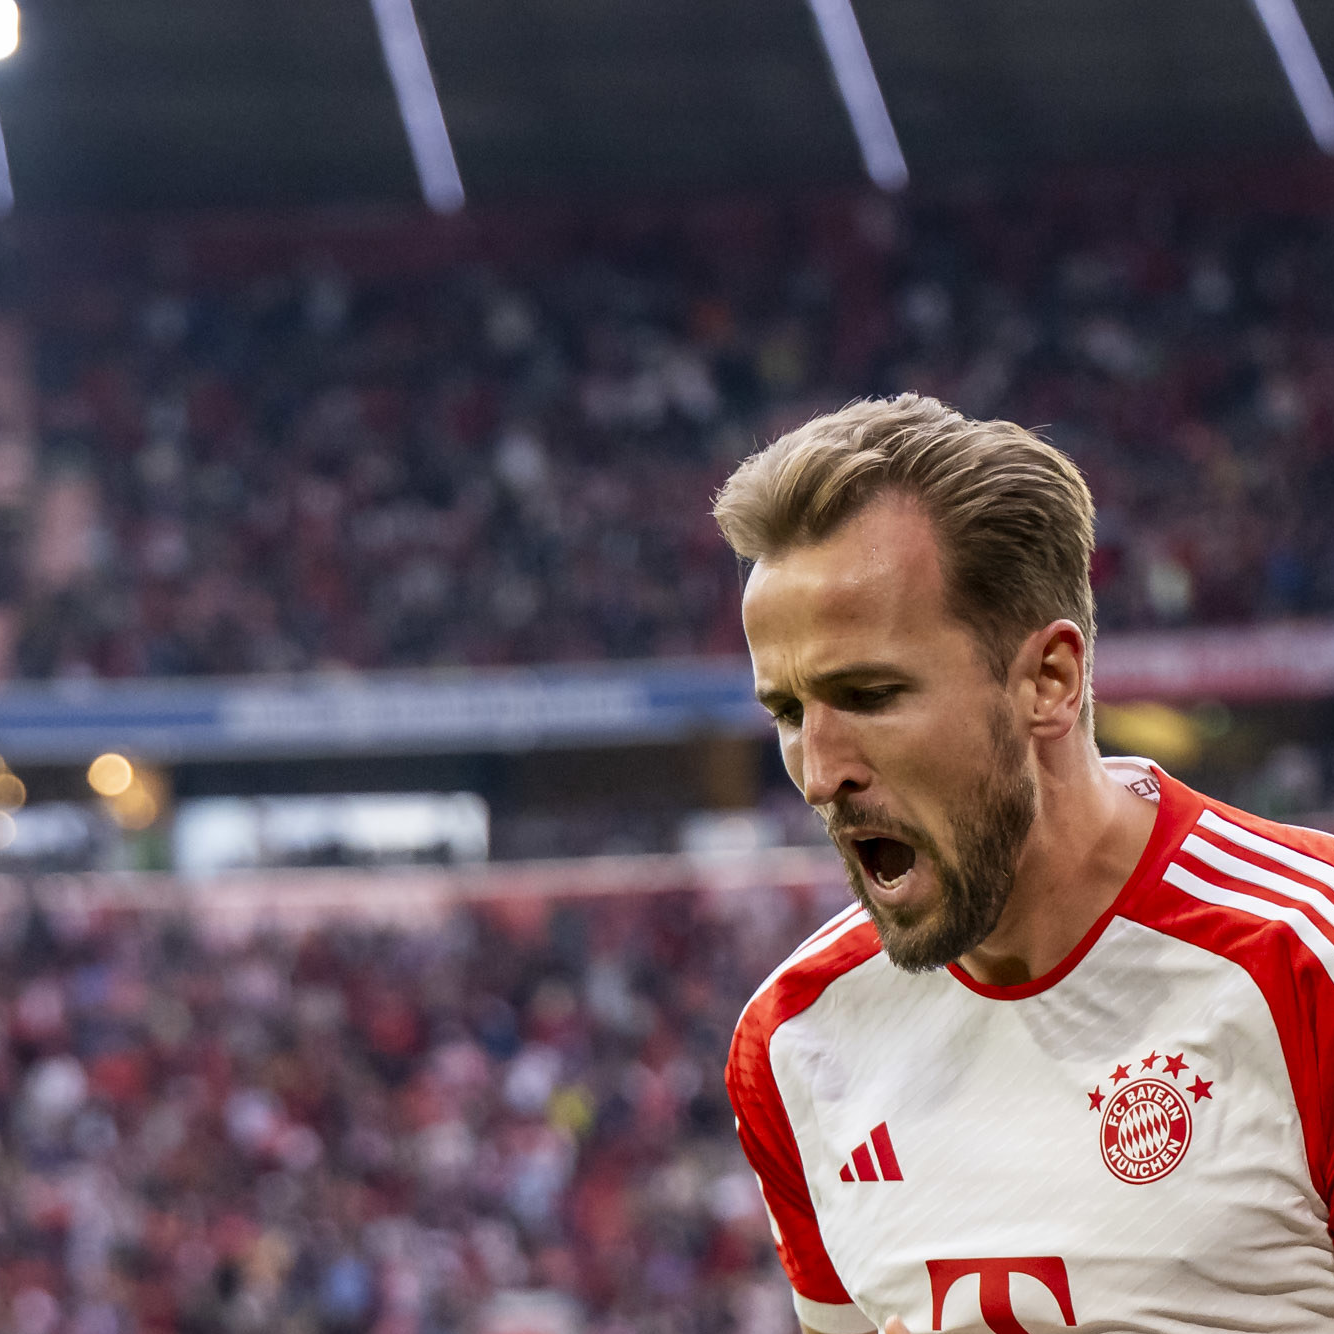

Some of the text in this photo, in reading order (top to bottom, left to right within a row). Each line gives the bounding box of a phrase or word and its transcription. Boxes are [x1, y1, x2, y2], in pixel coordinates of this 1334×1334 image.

[1107, 1085, 1183, 1128] FC BAYERN
[1107, 1138, 1182, 1177] MÜNCHEN
